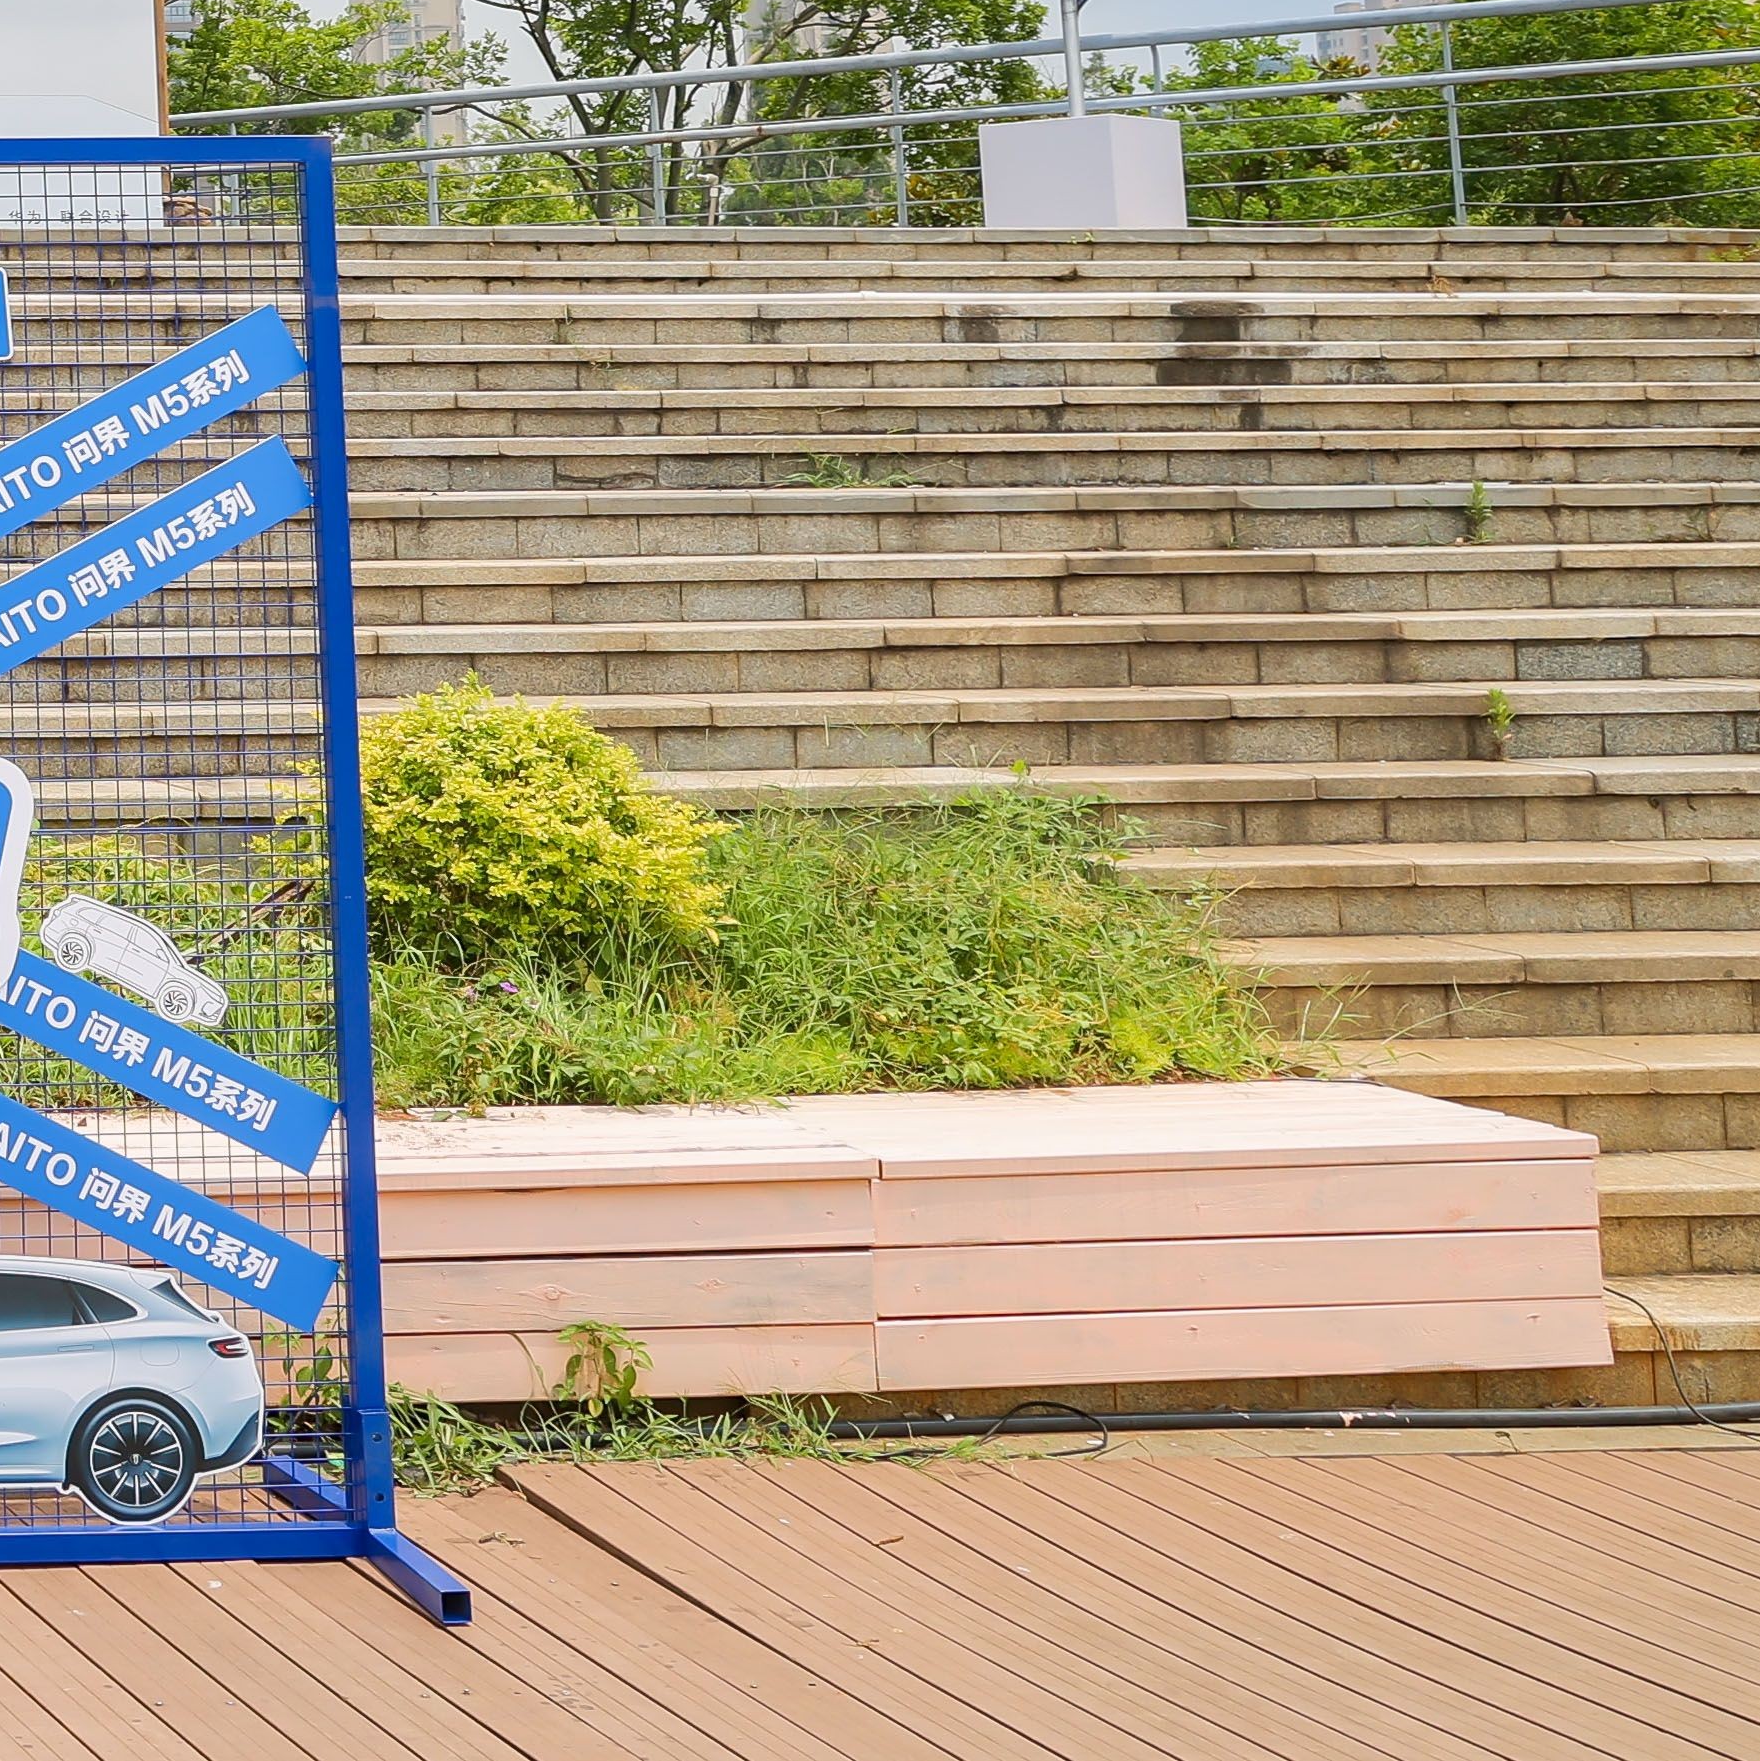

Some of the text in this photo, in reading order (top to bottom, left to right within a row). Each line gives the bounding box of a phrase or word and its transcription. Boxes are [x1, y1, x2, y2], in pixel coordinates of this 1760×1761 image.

[62, 413, 131, 476] 问界
[132, 348, 250, 436] M5系列
[68, 548, 136, 609] 问界
[136, 481, 257, 569] M5系列
[79, 1009, 152, 1068] 问界
[151, 1047, 278, 1134] M5系列
[79, 1166, 152, 1226] 问界
[151, 1201, 281, 1289] M5系列
